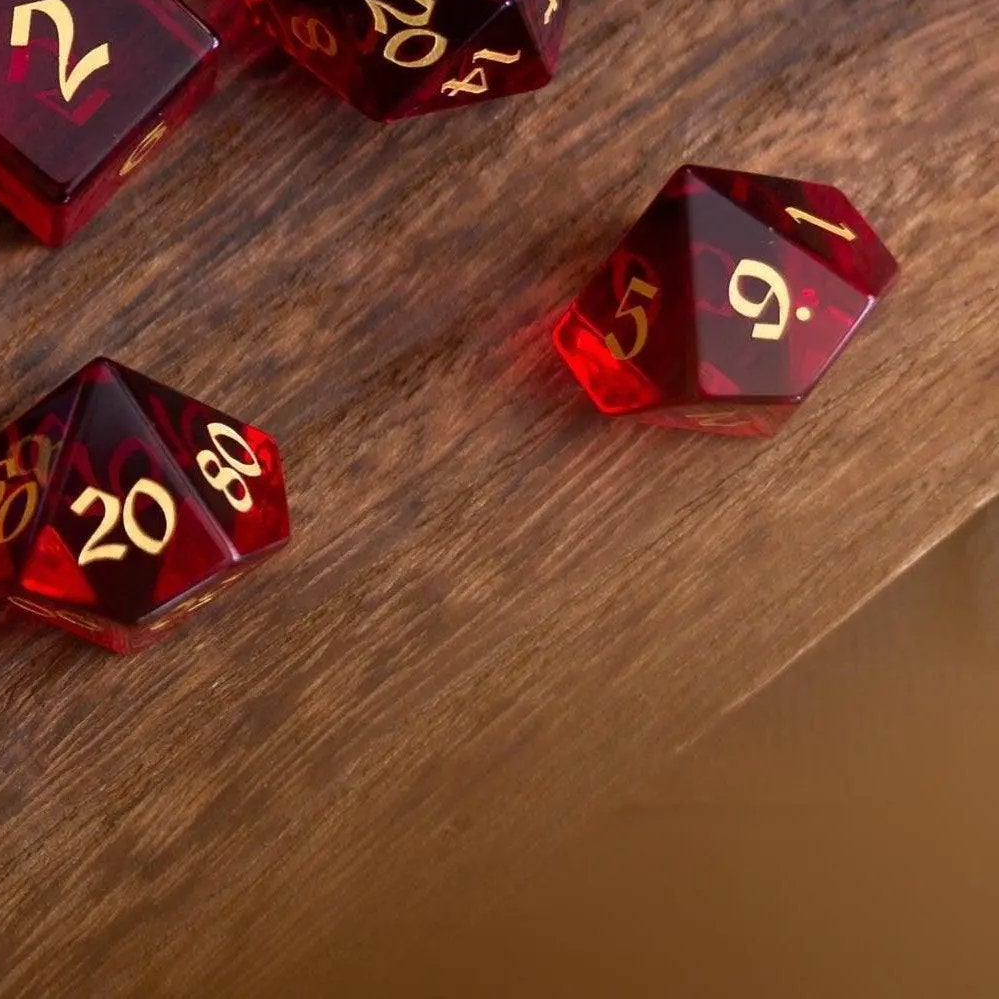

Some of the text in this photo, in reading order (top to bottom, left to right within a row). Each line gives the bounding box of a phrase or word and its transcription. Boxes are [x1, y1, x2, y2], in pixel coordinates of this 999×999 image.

[441, 49, 521, 97] 14
[784, 207, 856, 241] 1
[604, 277, 660, 360] 5
[196, 423, 262, 512] 80
[70, 478, 177, 566] 20
